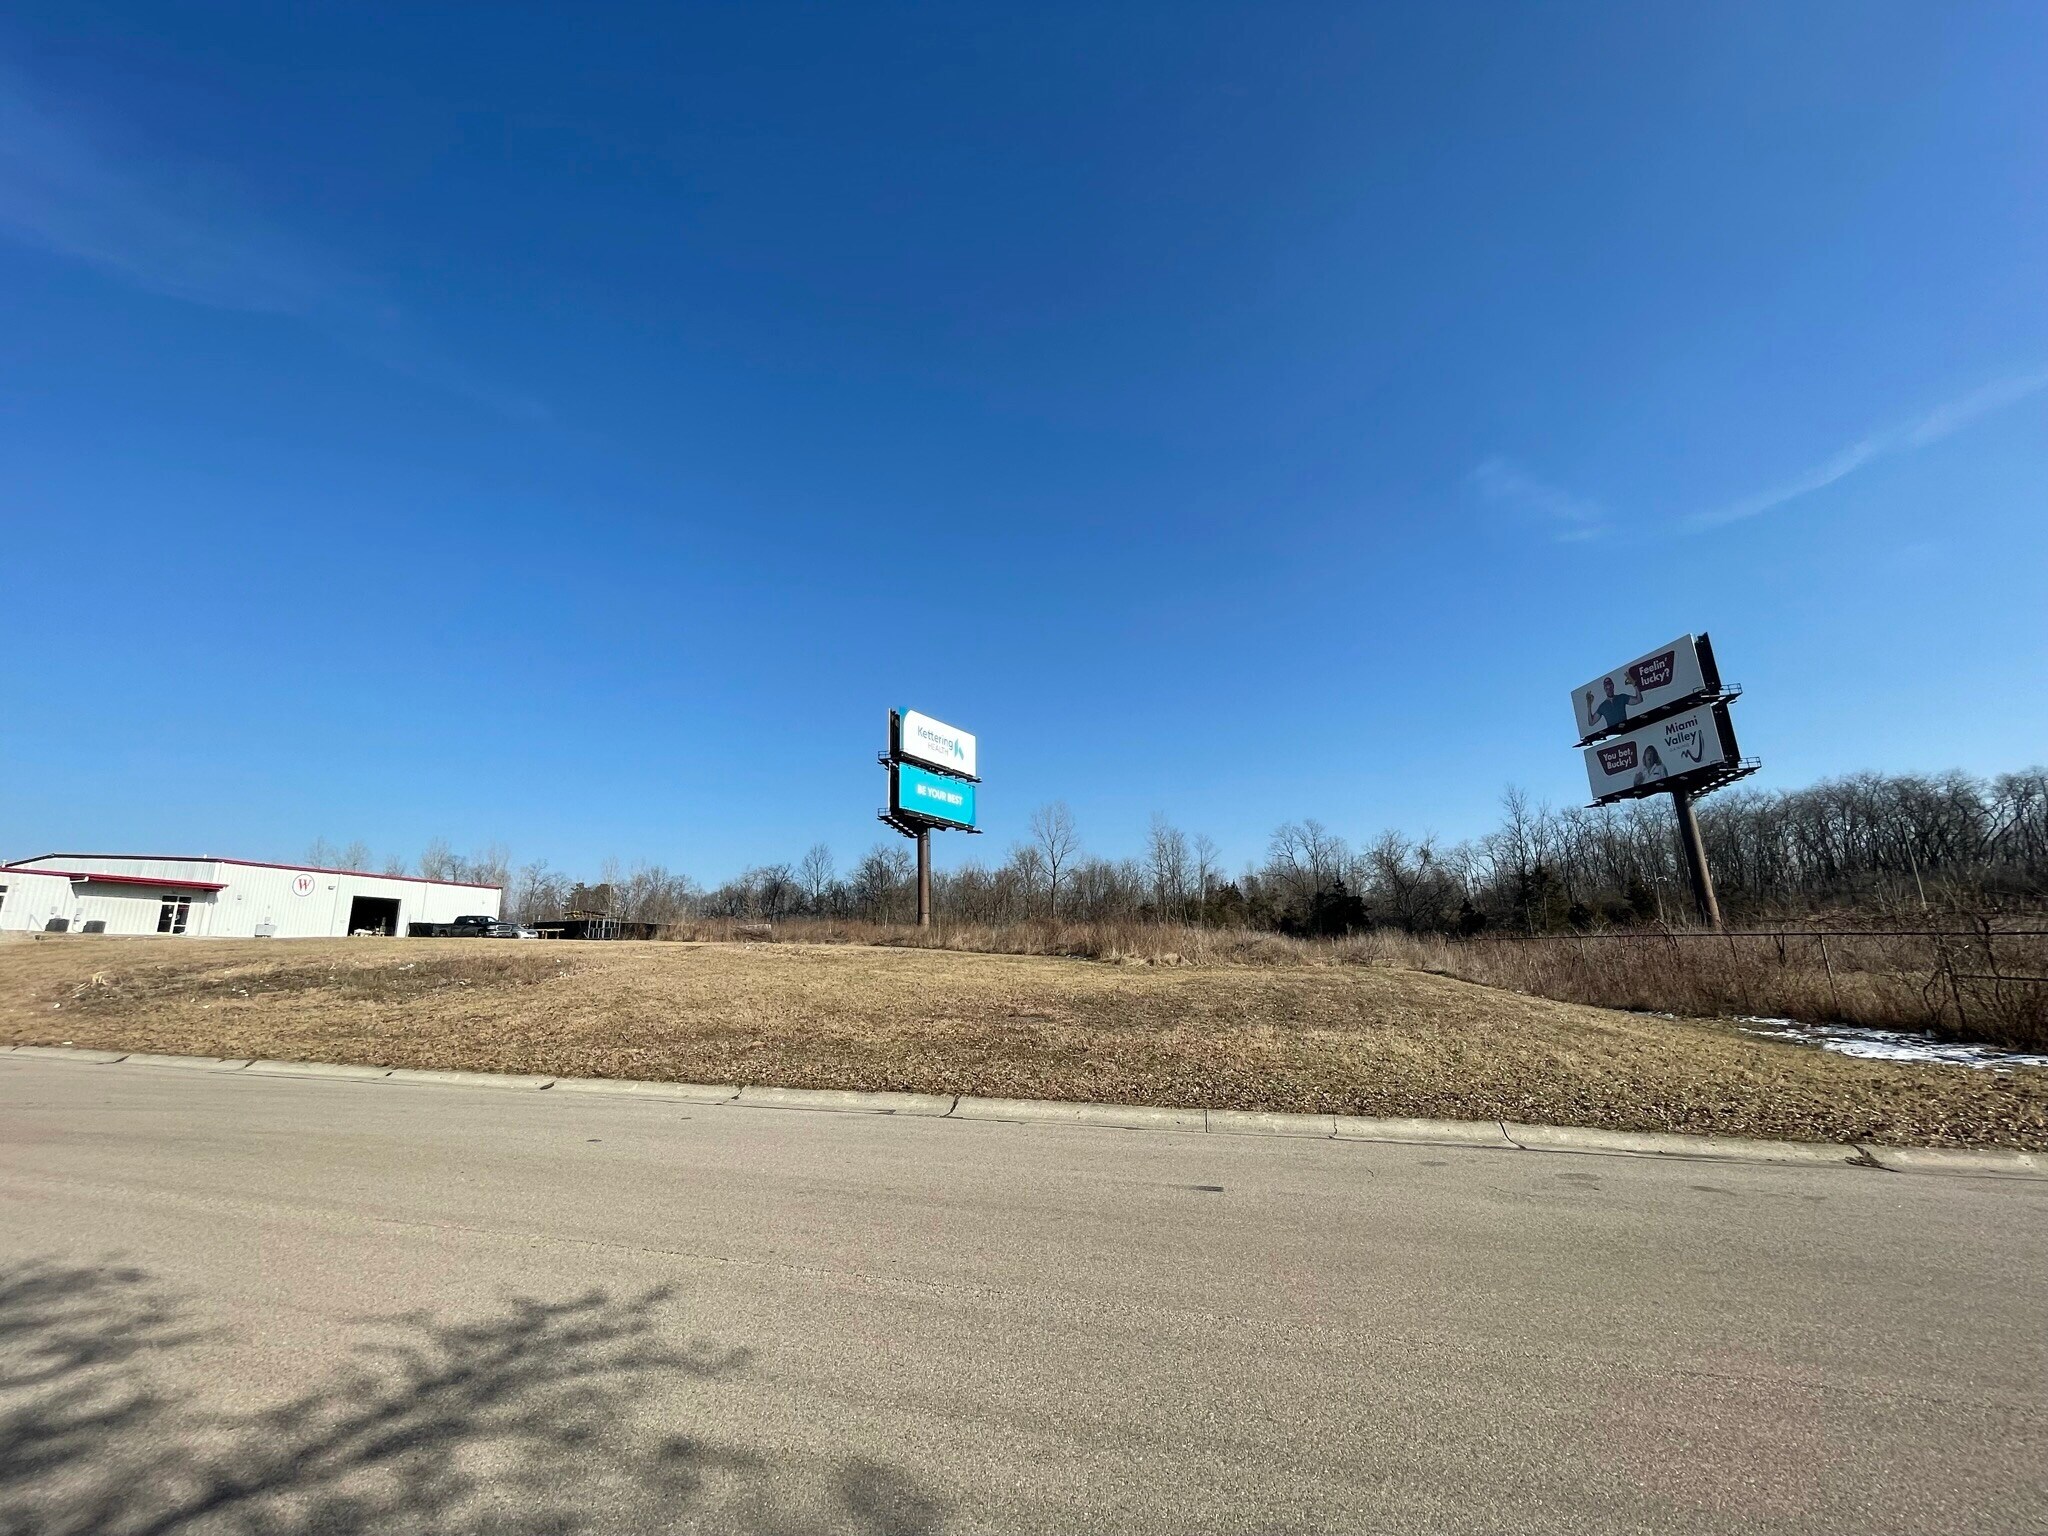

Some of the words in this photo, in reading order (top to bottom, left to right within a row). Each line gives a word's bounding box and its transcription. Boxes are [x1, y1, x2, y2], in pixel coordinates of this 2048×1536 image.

[1639, 657, 1668, 676] Feelin'
[1641, 668, 1670, 686] lucky?
[1665, 715, 1699, 736] Miami
[917, 725, 953, 751] Kettering
[1664, 731, 1697, 746] Valley
[928, 742, 949, 757] HEALTH
[1603, 751, 1618, 761] You
[1618, 748, 1633, 760] bet,
[1607, 757, 1632, 770] Bucky!
[917, 784, 927, 796] BE
[927, 787, 947, 801] YOUR
[947, 792, 963, 805] BEST
[298, 879, 312, 891] W
